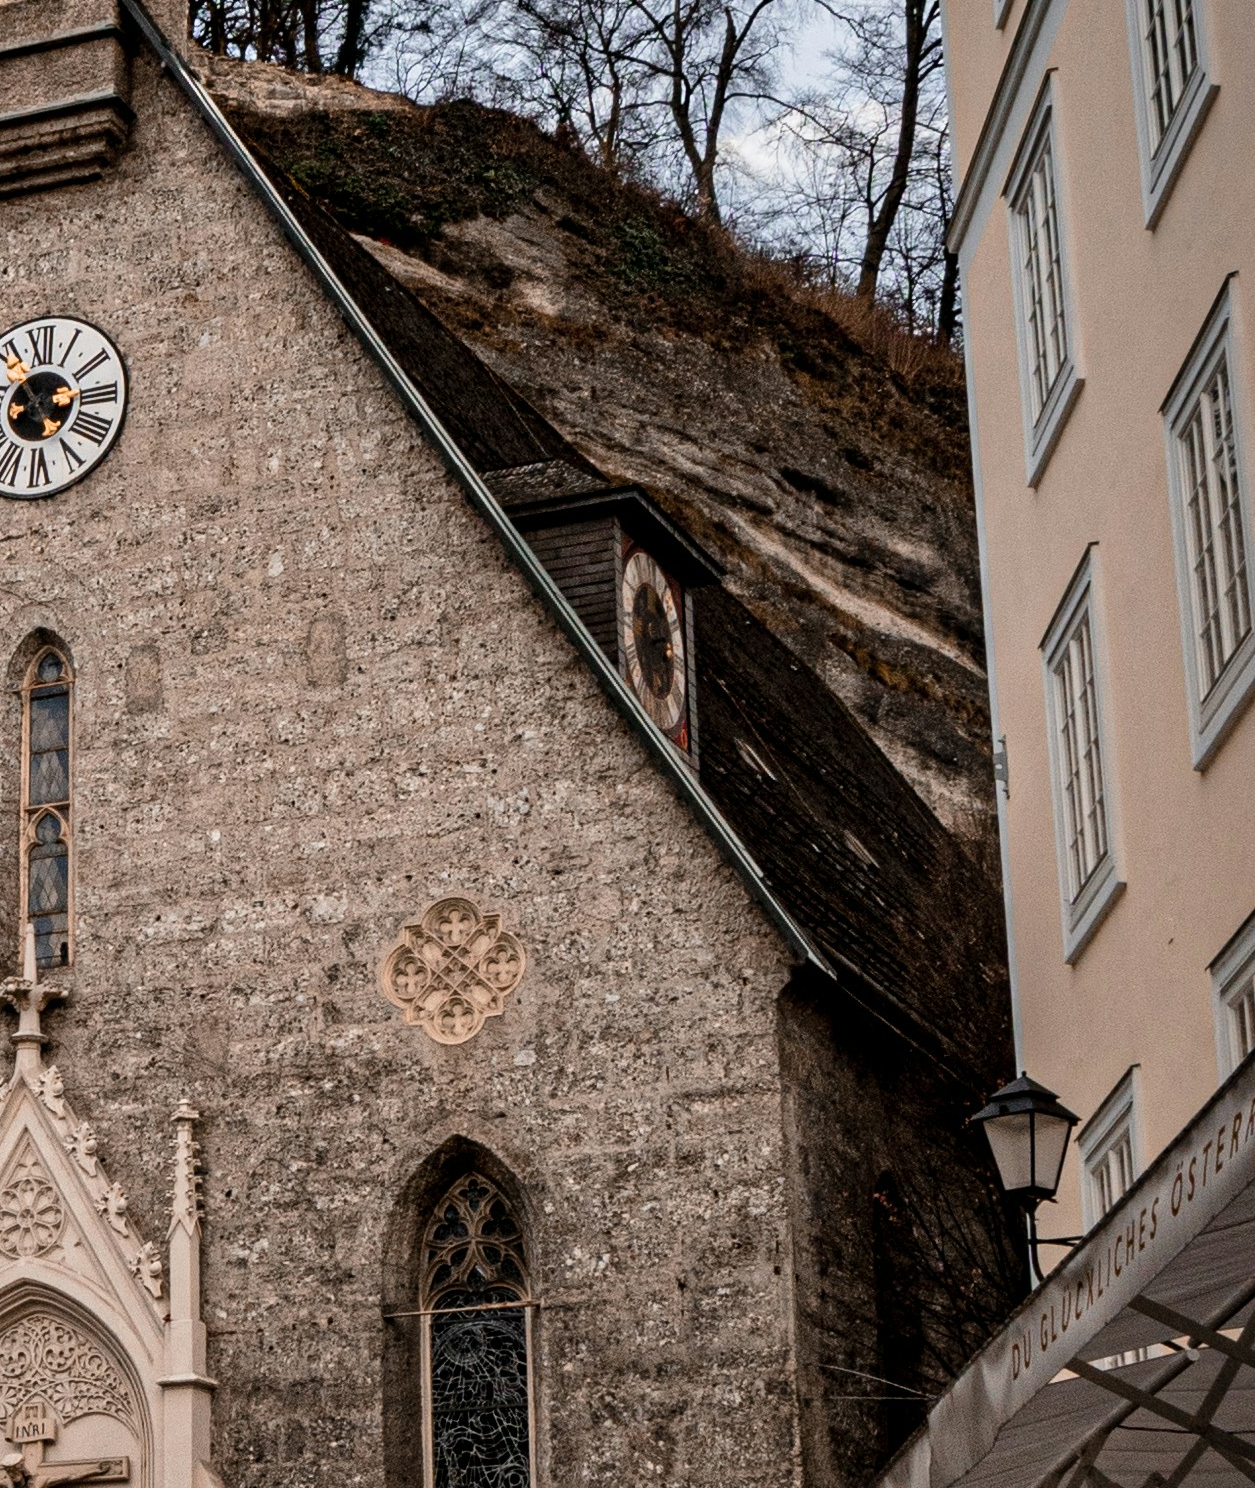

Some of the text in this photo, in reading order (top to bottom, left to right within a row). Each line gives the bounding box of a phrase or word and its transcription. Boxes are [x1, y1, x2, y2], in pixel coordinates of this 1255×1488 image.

[26, 326, 56, 368] XII
[58, 328, 82, 368] I
[72, 347, 110, 382] II
[80, 381, 117, 406] III
[68, 410, 113, 447] IIII
[27, 447, 52, 488] VI
[59, 437, 86, 474] V
[1012, 1330, 1033, 1381] DU
[1040, 1197, 1160, 1352] GLÜCKLICHES
